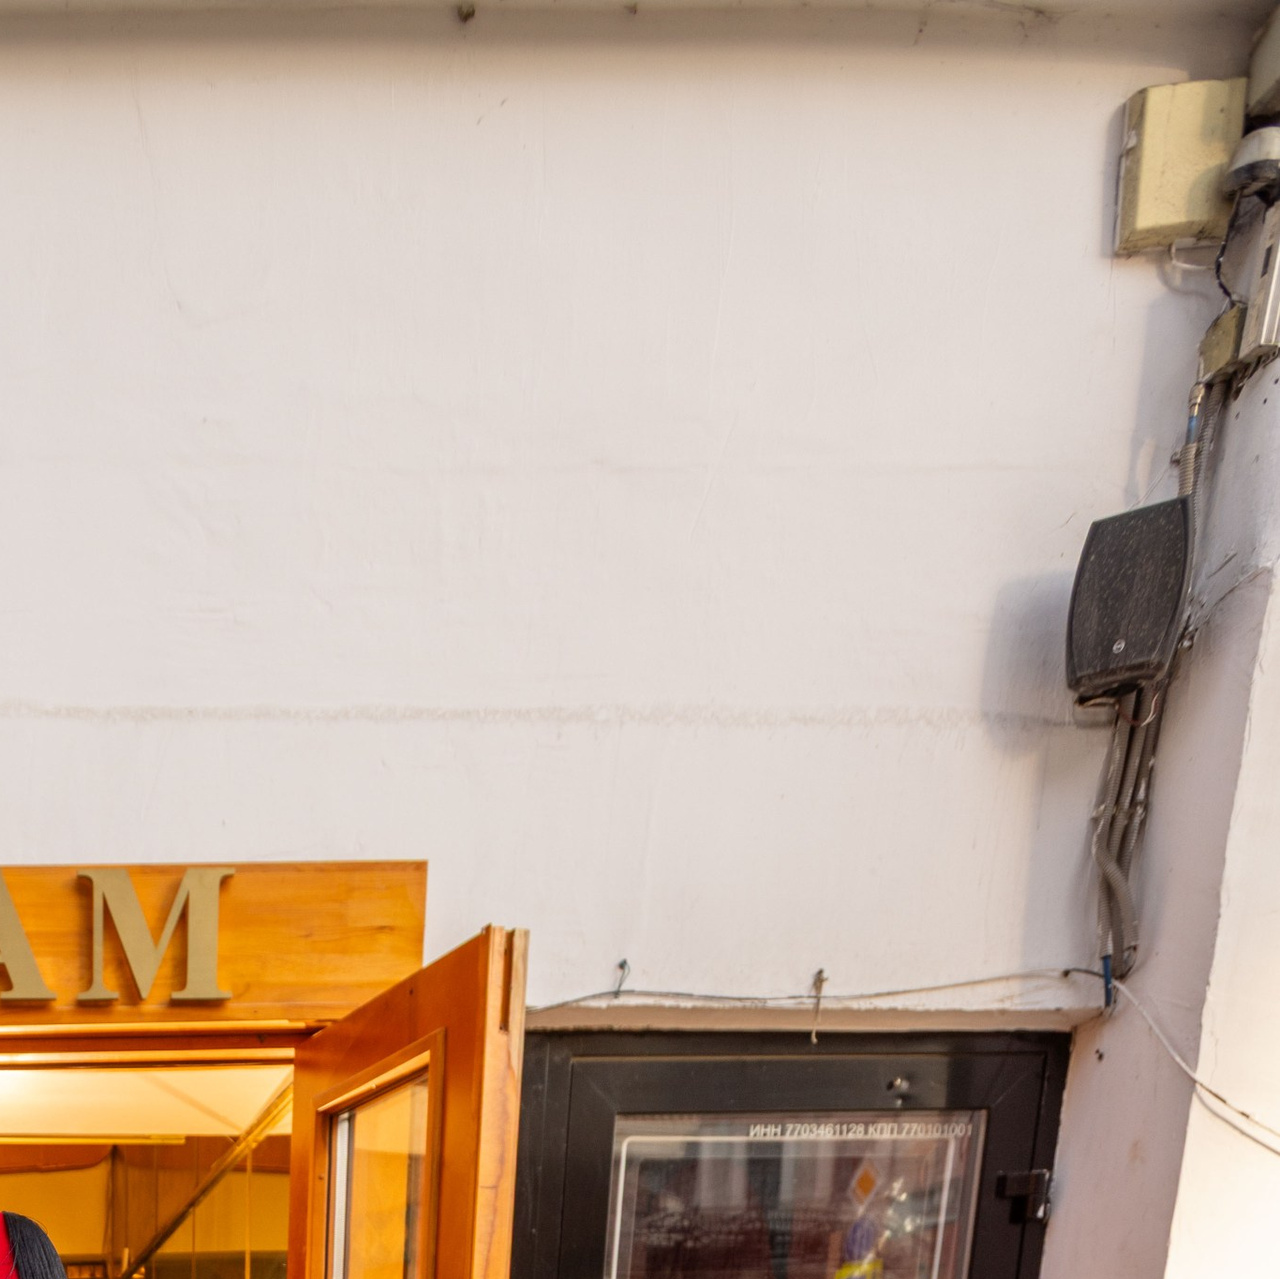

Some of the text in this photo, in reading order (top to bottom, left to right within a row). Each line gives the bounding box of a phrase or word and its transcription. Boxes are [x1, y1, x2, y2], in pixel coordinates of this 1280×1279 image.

[750, 1123, 973, 1137] ИНН 7703461128 КПП 770101001
